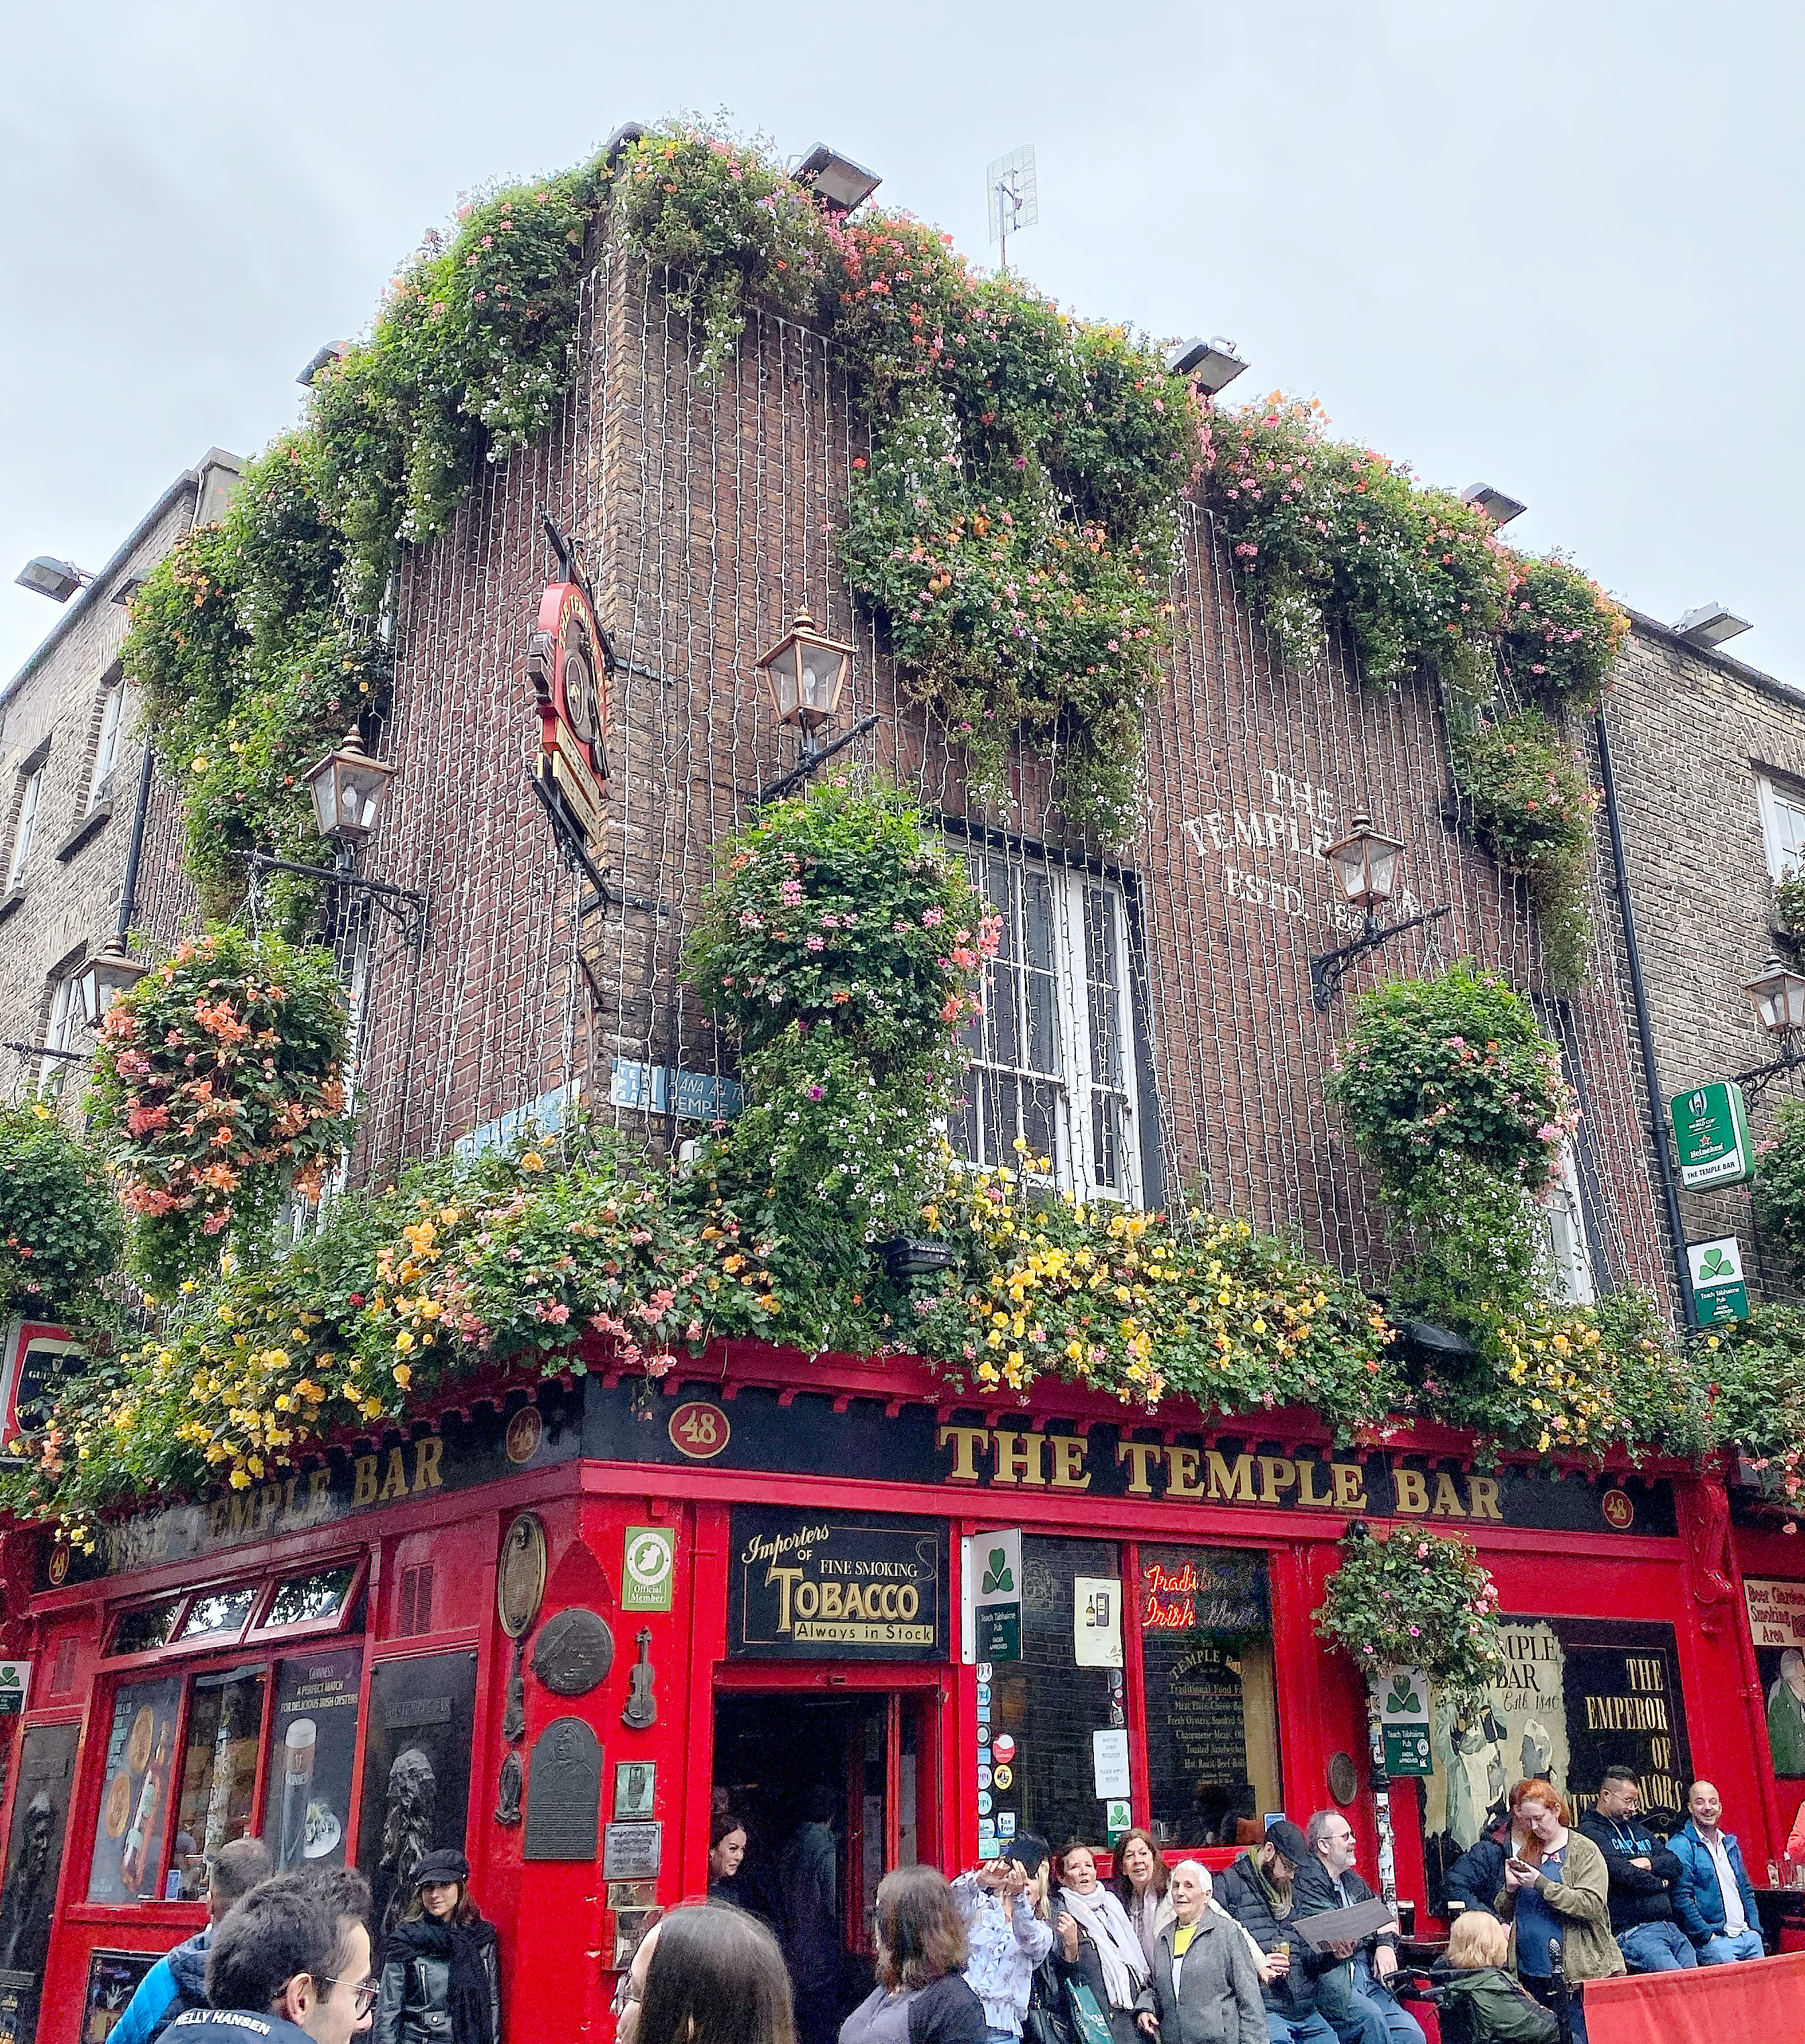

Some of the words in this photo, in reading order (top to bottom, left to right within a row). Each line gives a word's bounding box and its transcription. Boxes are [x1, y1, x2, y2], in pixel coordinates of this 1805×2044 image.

[1264, 768, 1336, 824] THE
[679, 1076, 704, 1094] ÁNA
[1690, 1143, 1724, 1159] Heineken
[1687, 1171, 1698, 1179] THE
[1699, 1165, 1721, 1176] TEMPLE
[1722, 1161, 1735, 1170] BAR
[679, 1410, 716, 1444] 48
[352, 1436, 443, 1508] BAR
[939, 1426, 1092, 1489] THE
[1117, 1441, 1368, 1510] TEMPLE
[1392, 1467, 1504, 1520] BAR
[643, 1534, 668, 1551] IRELAND
[741, 1524, 830, 1567] Importers
[797, 1549, 814, 1562] OF
[820, 1559, 852, 1575] FINE
[855, 1560, 918, 1578] SMOKING
[631, 1593, 664, 1603] Member
[633, 1585, 662, 1593] Official
[764, 1566, 920, 1634] TOBACCO
[1141, 1595, 1195, 1628] Irish
[1750, 1605, 1791, 1628] Smoking
[796, 1624, 856, 1640] Always
[865, 1625, 879, 1638] in
[885, 1624, 930, 1640] Stock
[1763, 1625, 1785, 1643] Area
[1495, 1634, 1557, 1661] MPLE
[1169, 1649, 1220, 1681] TEMPLE
[1626, 1658, 1663, 1691] THE
[1495, 1664, 1541, 1692] BAR
[302, 1683, 324, 1696] PERFECT
[325, 1680, 343, 1692] MATCH
[1213, 1684, 1232, 1695] Food
[280, 1702, 291, 1713] FOR
[292, 1698, 319, 1711] DELICIOUS
[319, 1696, 334, 1708] IRISH
[1584, 1696, 1668, 1731] EMPEROR
[1402, 1739, 1412, 1747] Pub
[1651, 1737, 1671, 1769] OF
[1000, 1817, 1011, 1825] tax
[1001, 1825, 1014, 1833] free
[174, 2011, 212, 2027] HELLY
[211, 2011, 271, 2037] HANSEN
